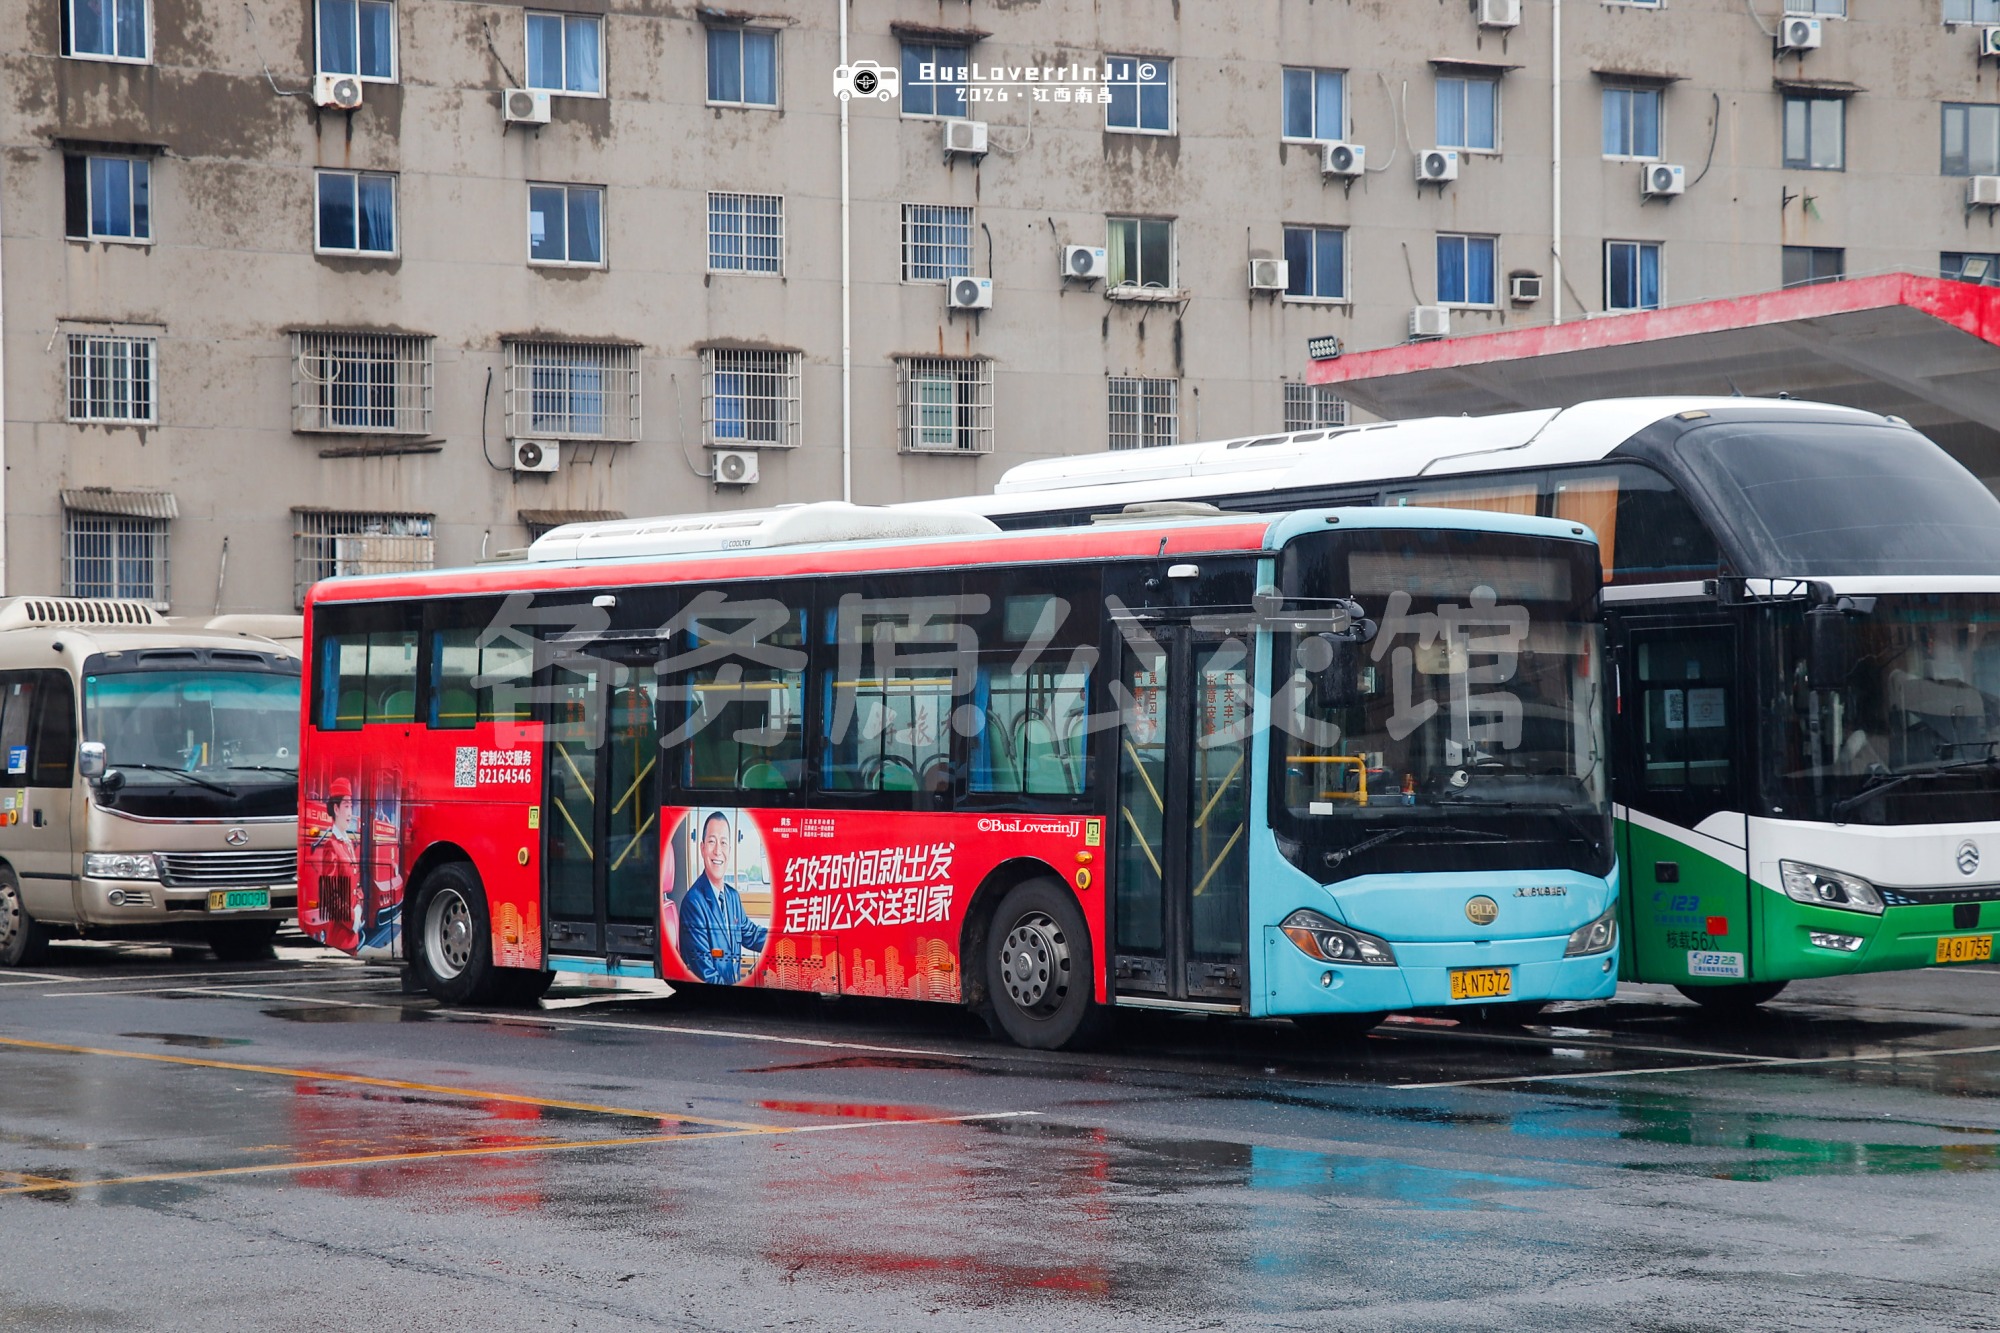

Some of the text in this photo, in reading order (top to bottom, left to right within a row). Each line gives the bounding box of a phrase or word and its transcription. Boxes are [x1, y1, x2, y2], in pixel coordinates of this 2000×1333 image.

[480, 750, 532, 766] 定制公交服务
[479, 768, 532, 784] 82164546
[782, 842, 955, 893] 约好时间就出发
[783, 884, 954, 933] 定制公交送到家
[1470, 904, 1497, 916] BLK
[1666, 930, 1720, 951] 核载56人
[1703, 954, 1737, 965] 12328
